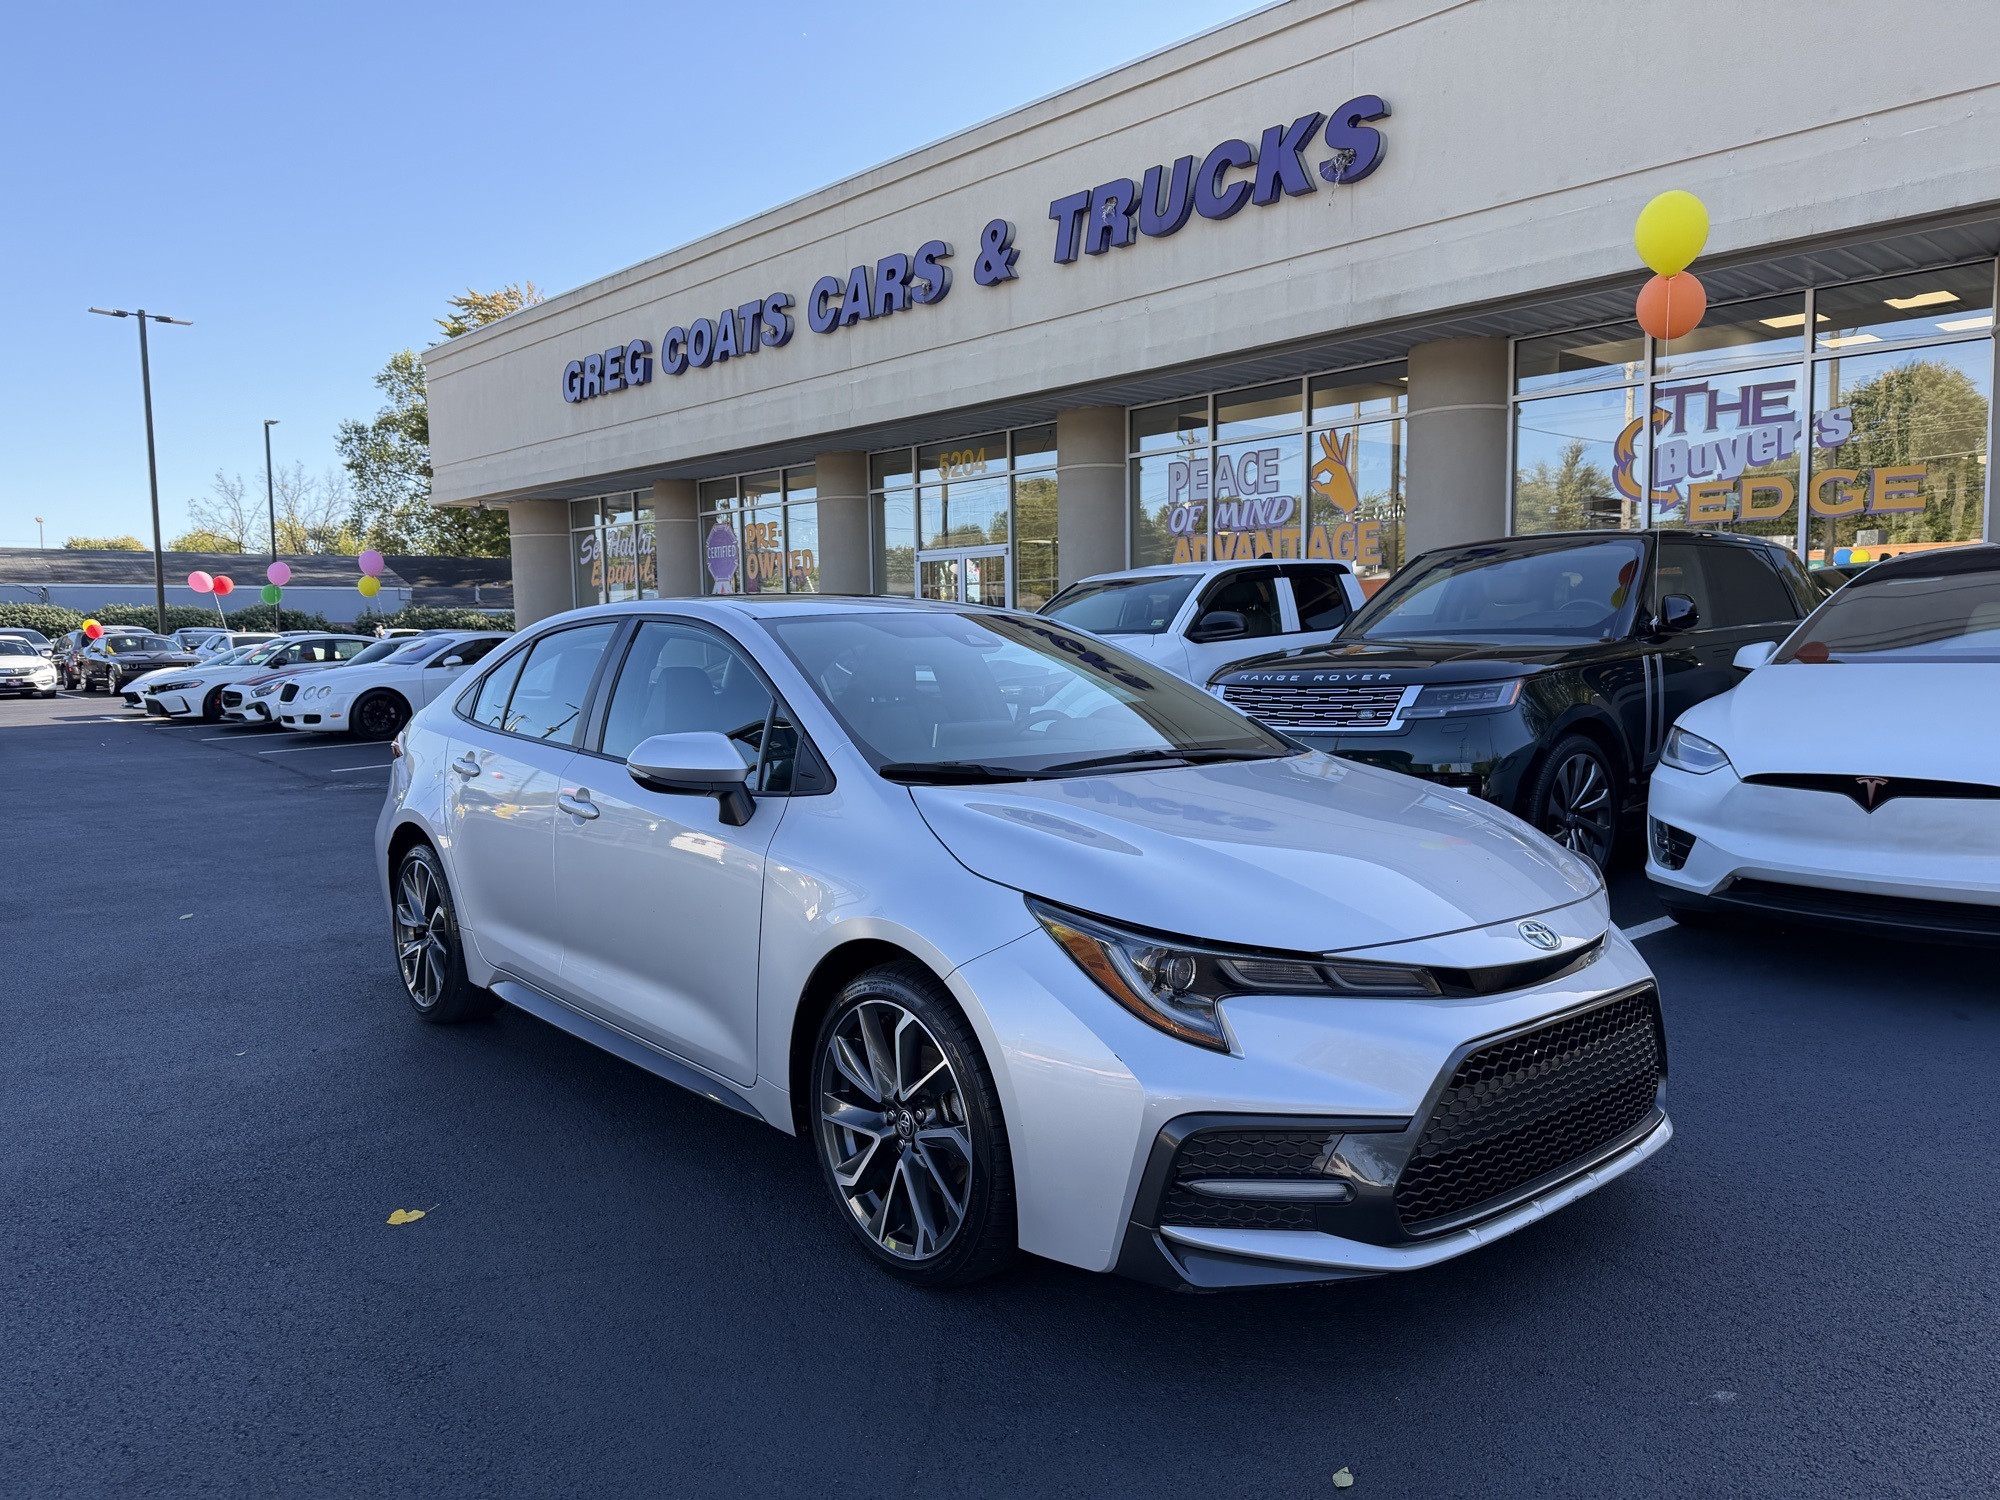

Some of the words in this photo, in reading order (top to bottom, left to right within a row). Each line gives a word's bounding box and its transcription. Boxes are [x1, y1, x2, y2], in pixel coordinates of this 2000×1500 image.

[563, 339, 652, 403] GREG
[661, 292, 796, 376] COATS
[808, 239, 955, 334] CARS
[973, 218, 1020, 287] &
[1049, 94, 1392, 265] TRUCKS
[1654, 380, 1796, 438] THE
[939, 447, 987, 481] 5204
[1168, 448, 1280, 505] PEACE
[1686, 465, 1928, 525] EDGE
[1168, 505, 1205, 536] OF
[1214, 495, 1296, 532] MIND
[580, 534, 601, 566] Se
[707, 547, 737, 560] CERTIFIED
[746, 548, 815, 580] OWNED
[1239, 674, 1300, 682] RANGE
[1313, 673, 1392, 682] ROVER
